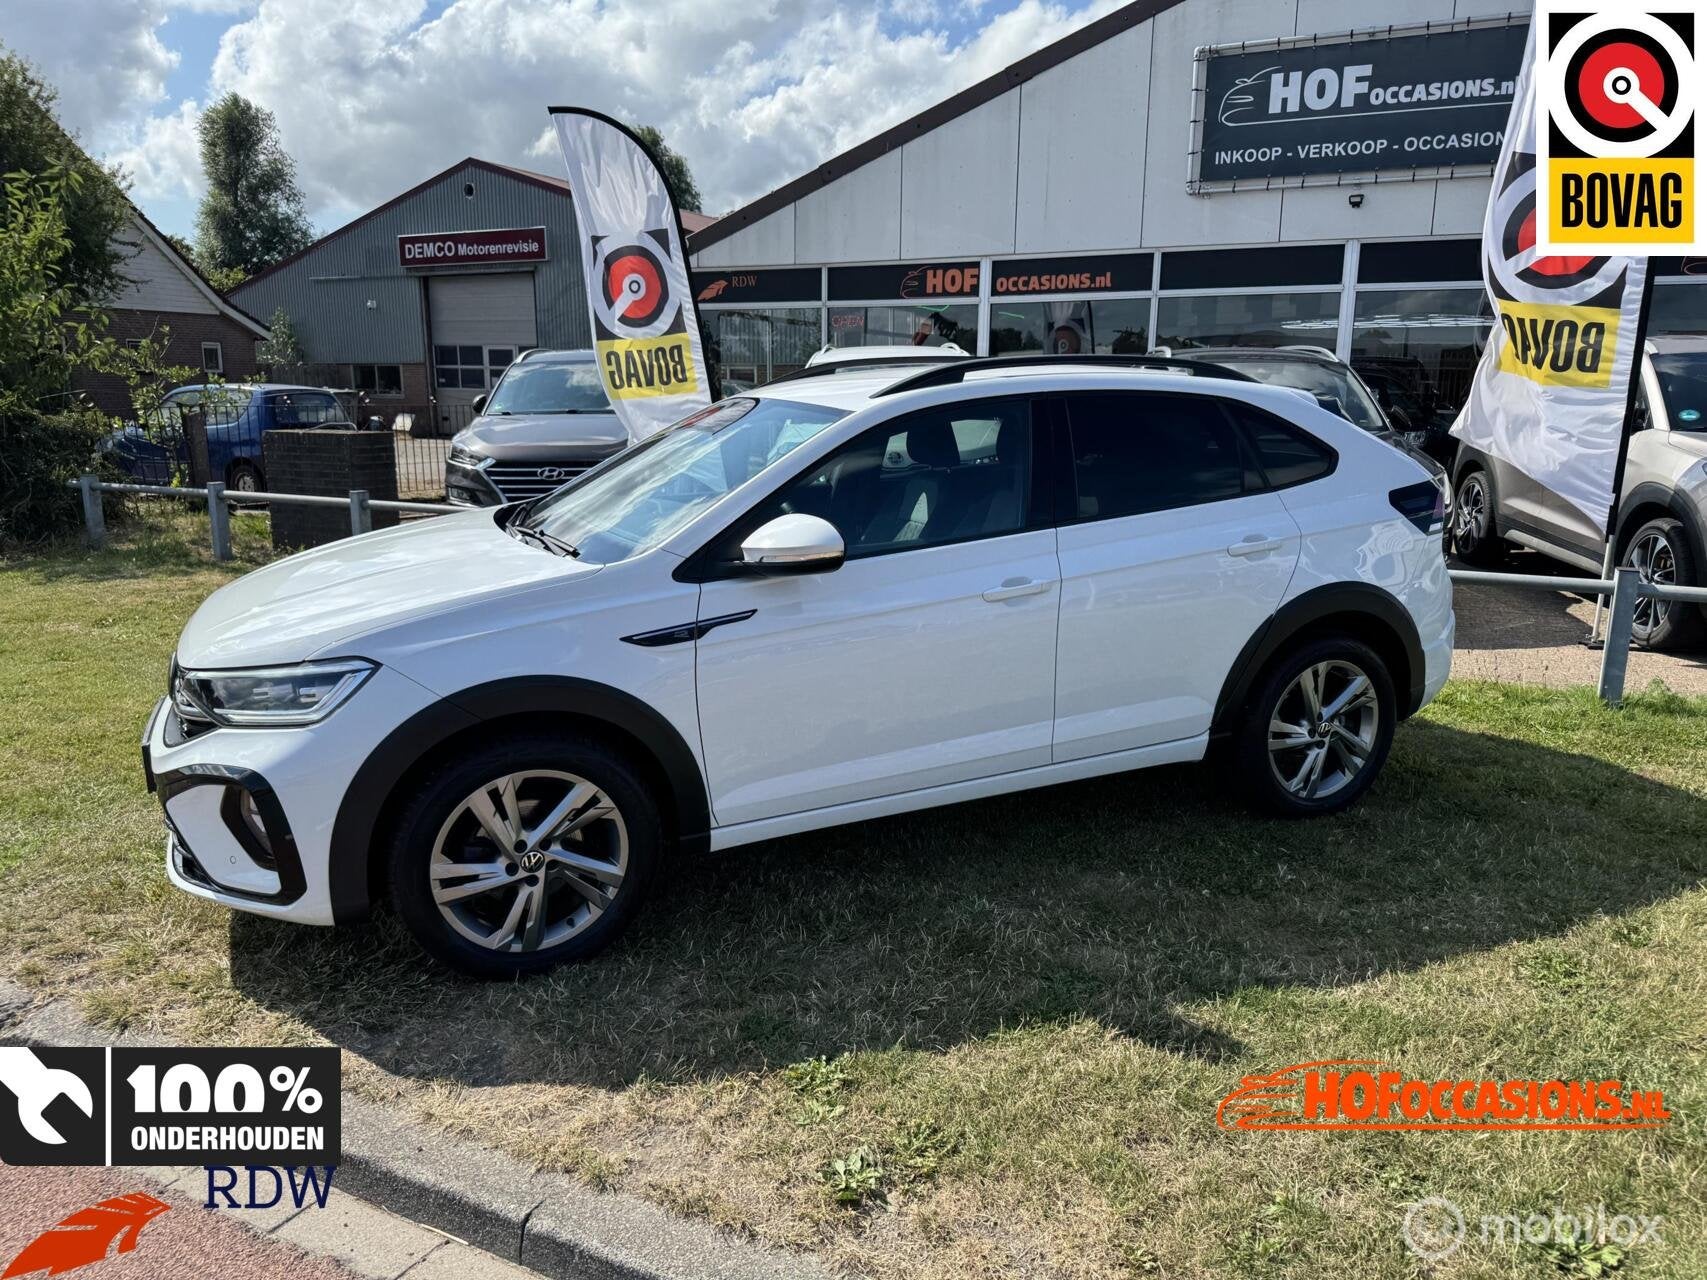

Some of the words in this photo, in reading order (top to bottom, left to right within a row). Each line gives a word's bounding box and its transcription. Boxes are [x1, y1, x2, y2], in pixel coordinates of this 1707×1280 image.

[1214, 147, 1282, 165] INKOOP
[1297, 139, 1388, 159] VERKOOP
[404, 241, 455, 259] DEMCO
[457, 239, 539, 256] Motorenrevisie
[731, 275, 758, 288] RDW
[925, 268, 979, 294] HOF
[996, 271, 1112, 292] OCCASIONS.nl
